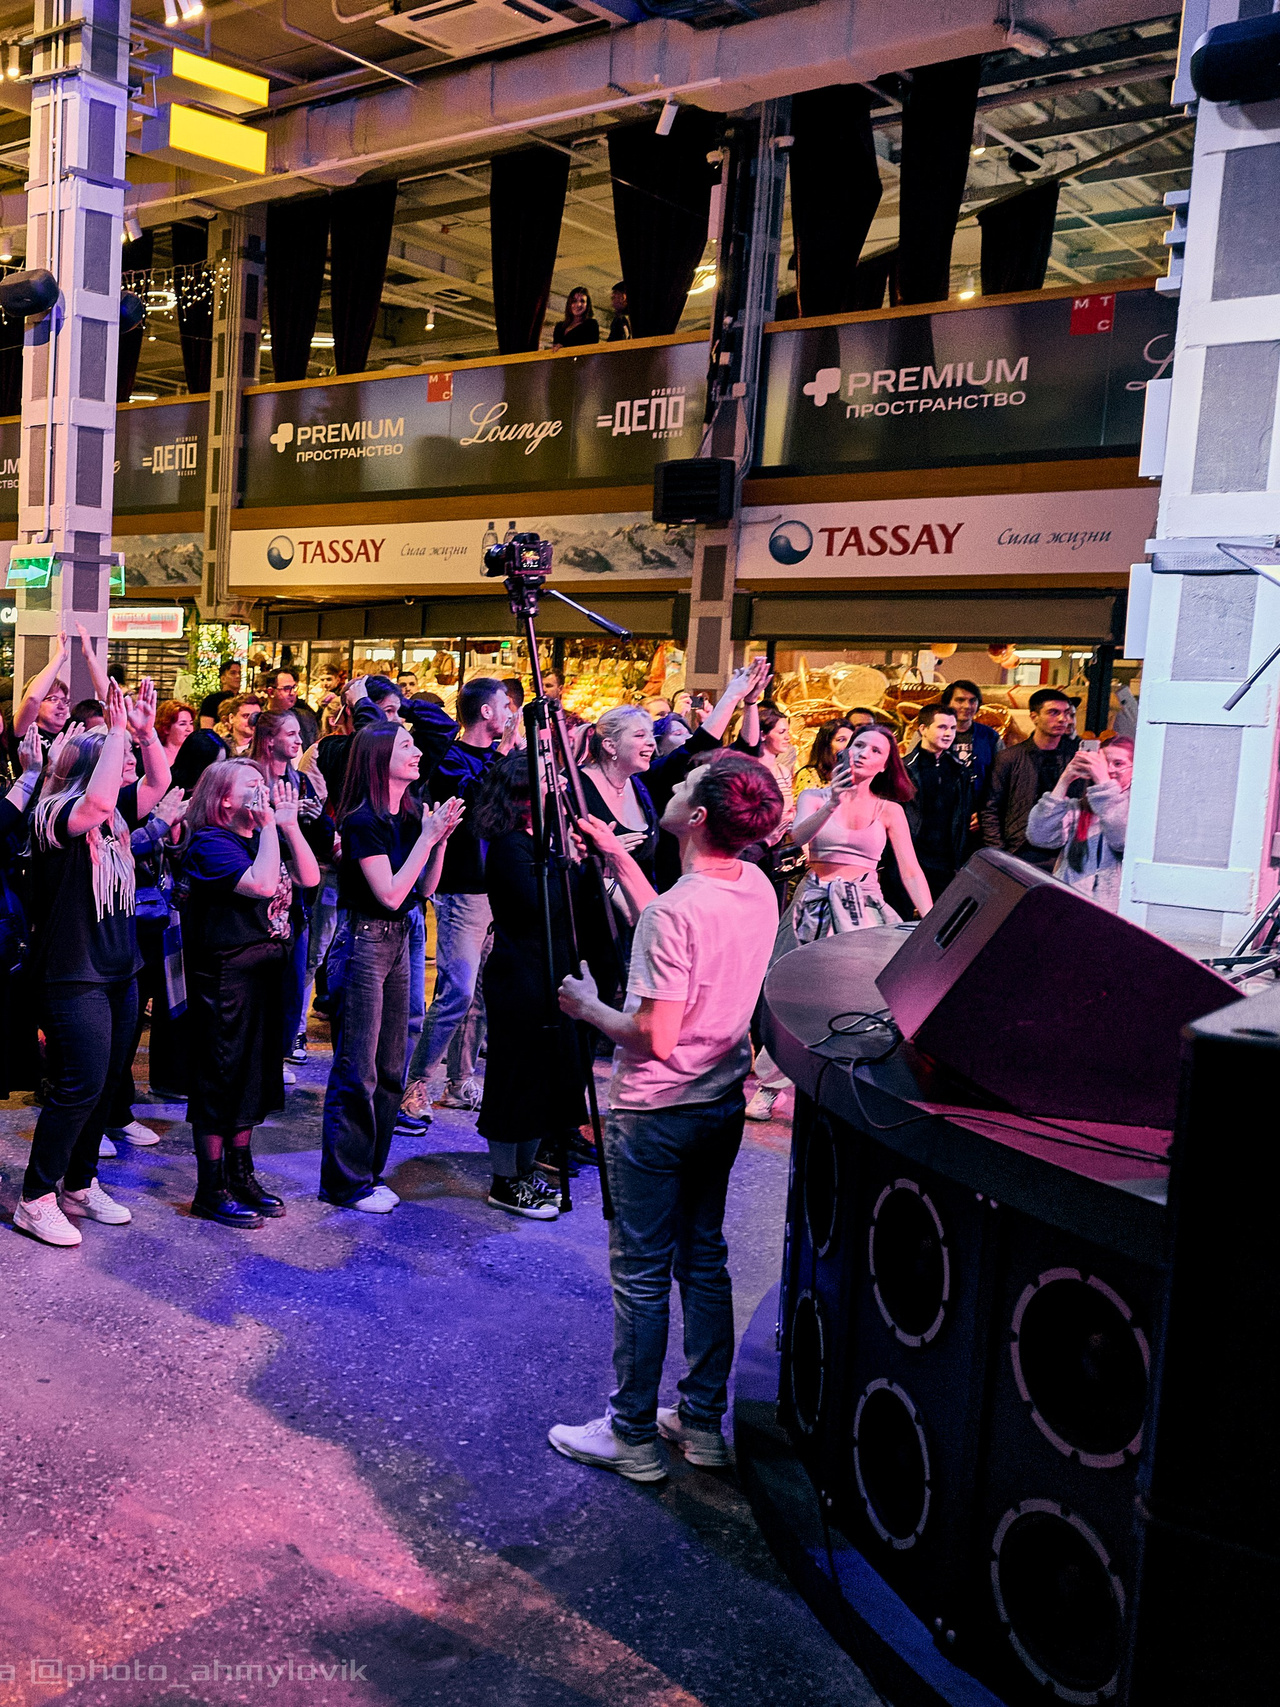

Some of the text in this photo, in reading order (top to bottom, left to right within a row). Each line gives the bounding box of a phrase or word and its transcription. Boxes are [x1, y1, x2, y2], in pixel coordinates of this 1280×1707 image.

[847, 356, 1030, 396] PREMIUM
[845, 391, 1027, 419] ПРОСТРАНСТВО
[297, 417, 404, 446] PREMIUM
[460, 402, 563, 456] Lounge
[296, 443, 404, 463] ПРОСТРАНСТВО
[298, 538, 469, 564] TASSAY Сила жизни
[817, 522, 1113, 557] TASSAY Сила жизни
